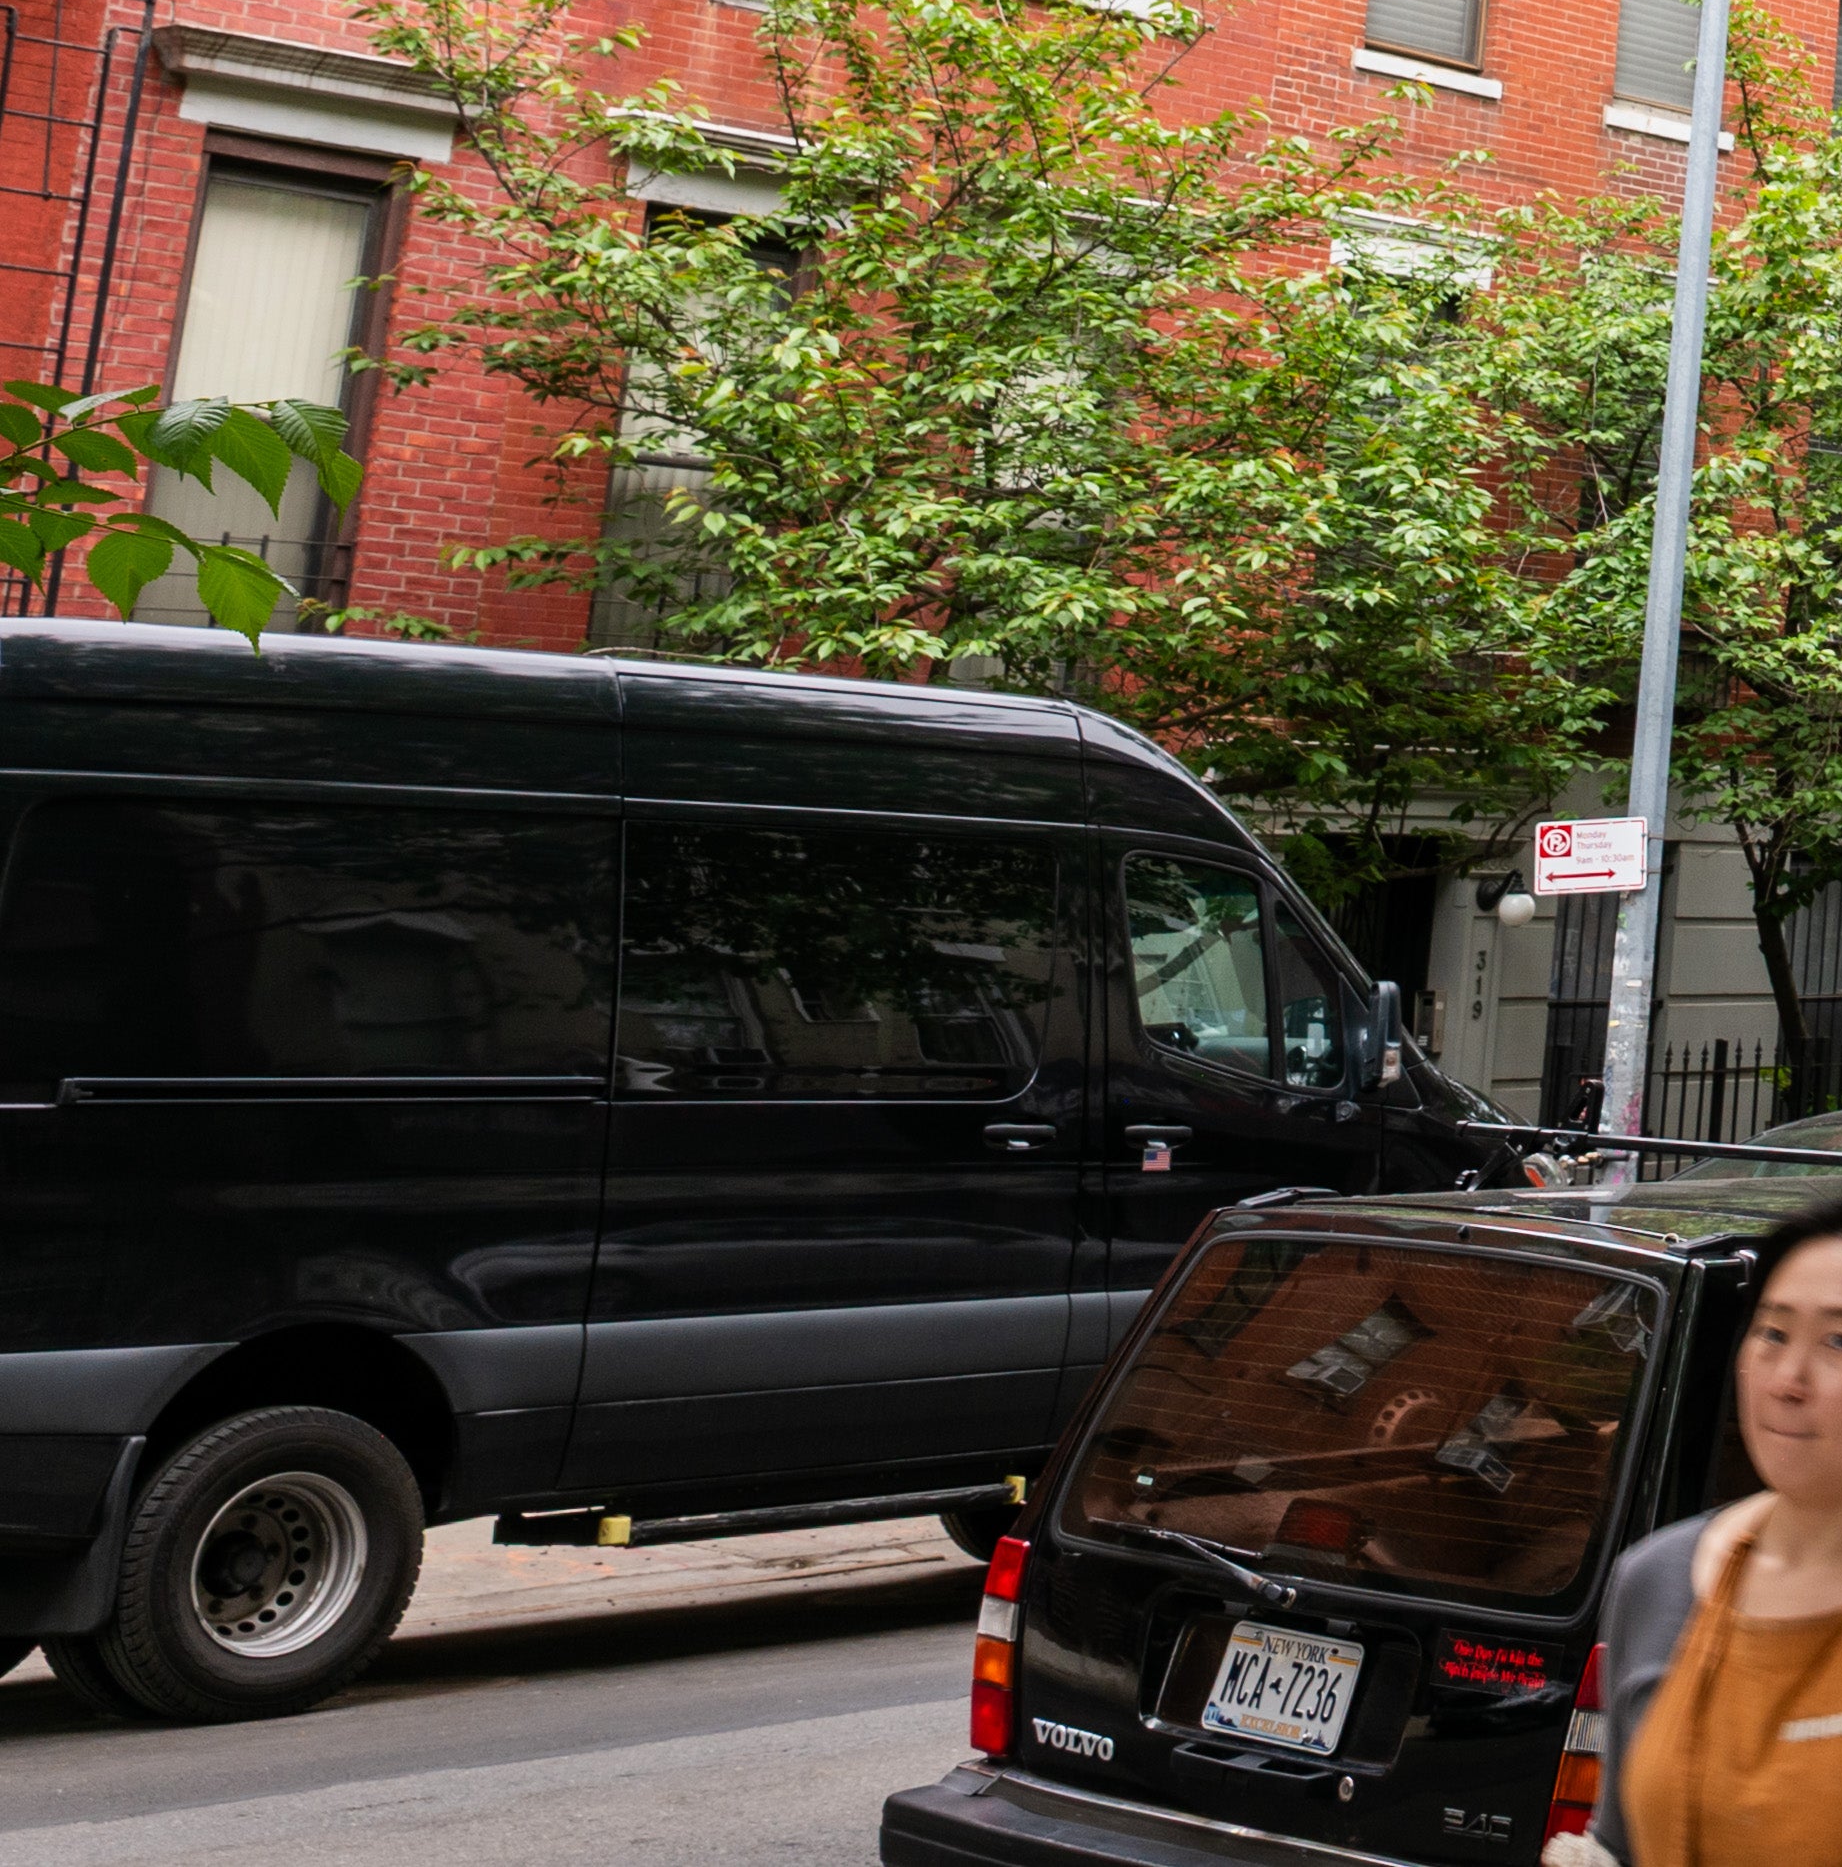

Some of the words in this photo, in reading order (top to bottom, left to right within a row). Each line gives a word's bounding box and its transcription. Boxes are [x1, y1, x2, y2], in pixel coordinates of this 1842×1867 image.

[1576, 831, 1607, 839] Monday
[1577, 841, 1612, 850] Thursday
[1472, 950, 1487, 1021] 319
[1262, 1636, 1295, 1658] NEW
[1296, 1641, 1330, 1665] YORK
[1032, 1717, 1114, 1761] VOLVO
